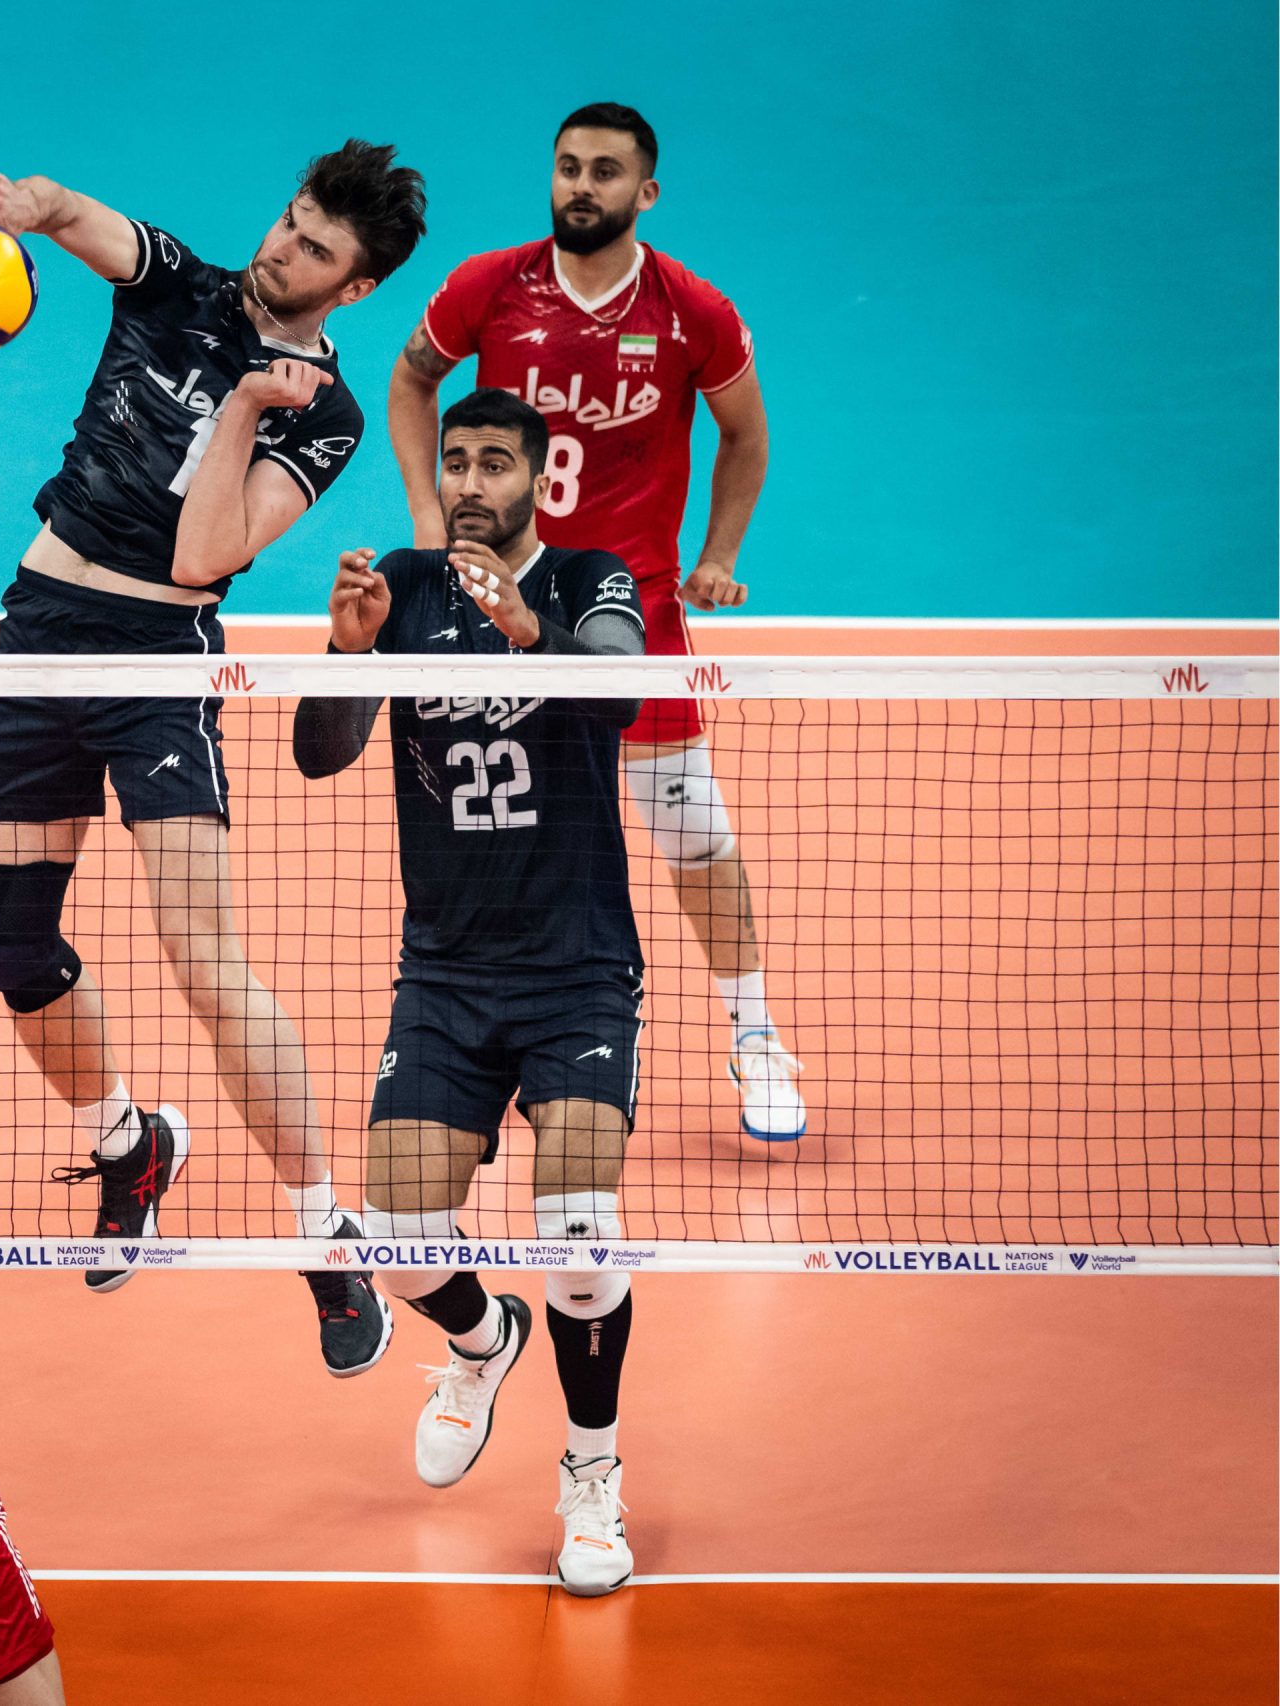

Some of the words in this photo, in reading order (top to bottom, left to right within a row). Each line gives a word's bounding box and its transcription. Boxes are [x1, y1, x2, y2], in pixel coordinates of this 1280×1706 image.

[539, 434, 584, 518] 8
[210, 661, 257, 692] VNL
[685, 662, 731, 693] VNL
[1162, 663, 1209, 693] VNL
[446, 738, 538, 831] 22
[57, 1246, 106, 1255] NATIONS
[143, 1248, 187, 1257] Volleyball
[525, 1246, 575, 1255] NATIONS
[612, 1249, 656, 1258] Volleyball
[143, 1256, 173, 1264] World
[324, 1246, 353, 1265] VNL
[355, 1246, 521, 1265] VOLLEYBALL
[1005, 1252, 1054, 1261] NATIONS
[1091, 1255, 1136, 1264] Volleyball
[57, 1256, 100, 1265] LEAGUE
[525, 1256, 569, 1265] LEAGUE
[612, 1257, 641, 1266] World
[803, 1250, 832, 1269] VNL
[835, 1251, 1001, 1271] VOLLEYBALL
[1005, 1262, 1049, 1271] LEAGUE
[1091, 1263, 1121, 1271] World
